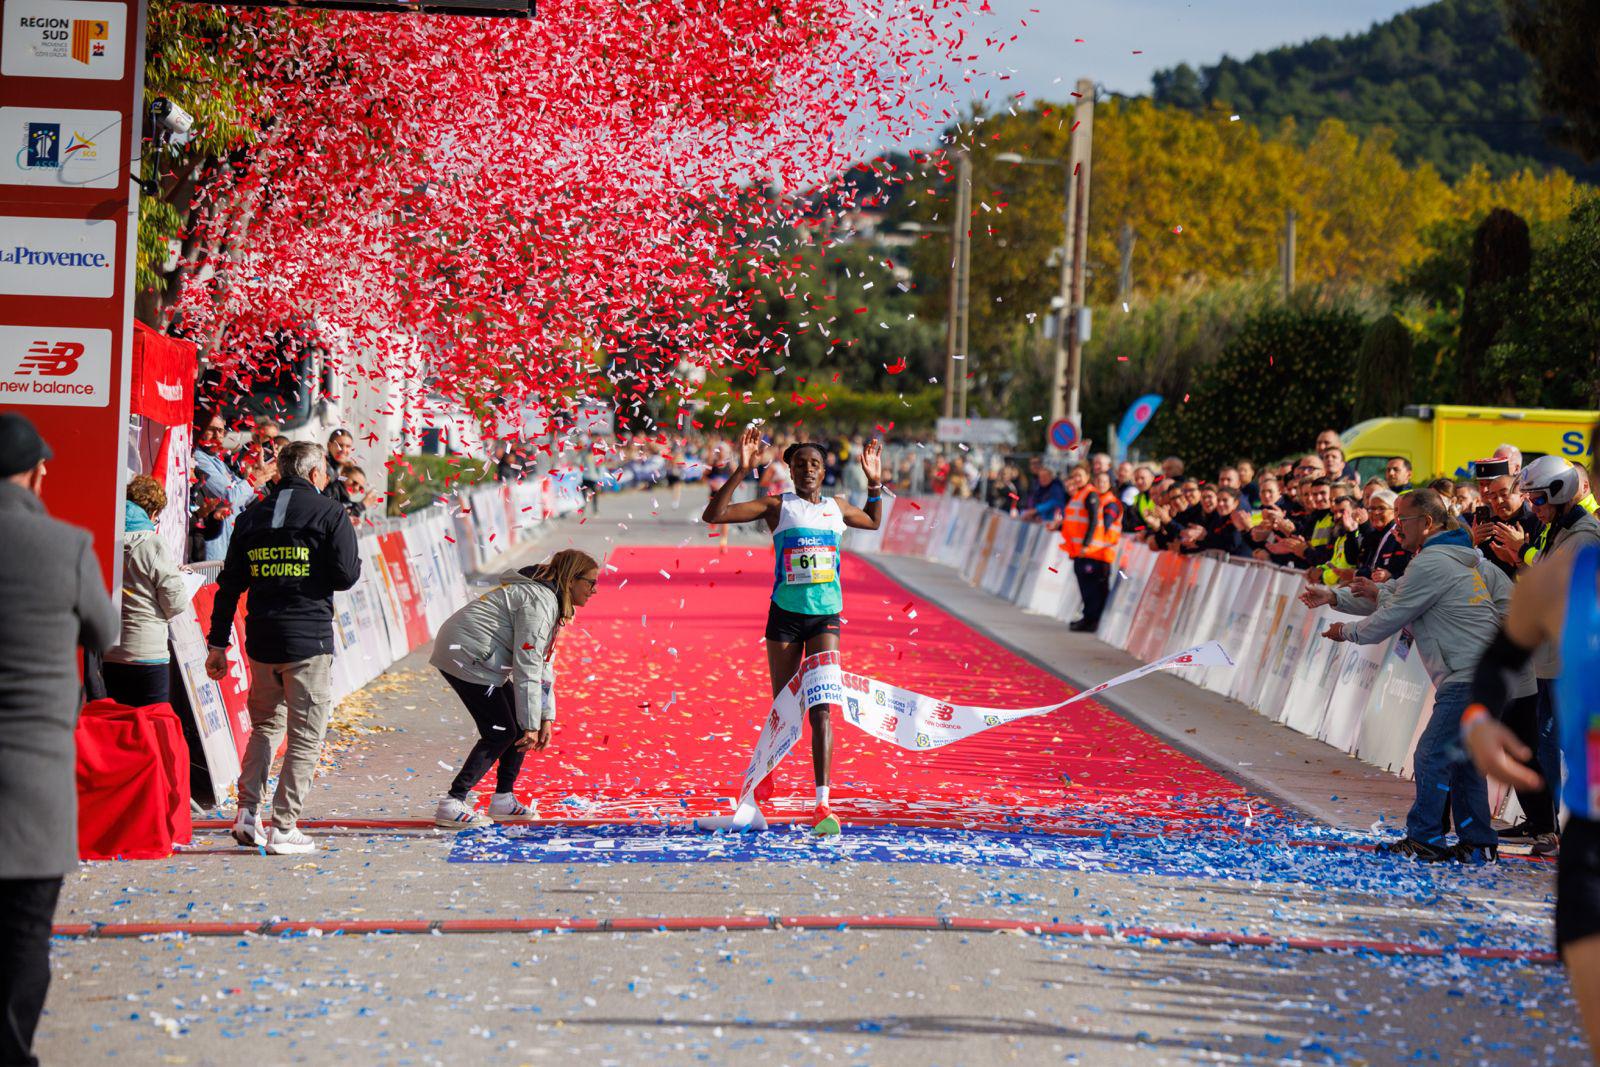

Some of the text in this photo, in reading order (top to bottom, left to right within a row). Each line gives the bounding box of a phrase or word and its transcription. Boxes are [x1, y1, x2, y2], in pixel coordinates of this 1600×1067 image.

[42, 30, 69, 40] SUD
[0, 380, 94, 395] new balance
[800, 553, 817, 569] 61
[261, 563, 310, 577] COURSE
[808, 692, 822, 704] DU
